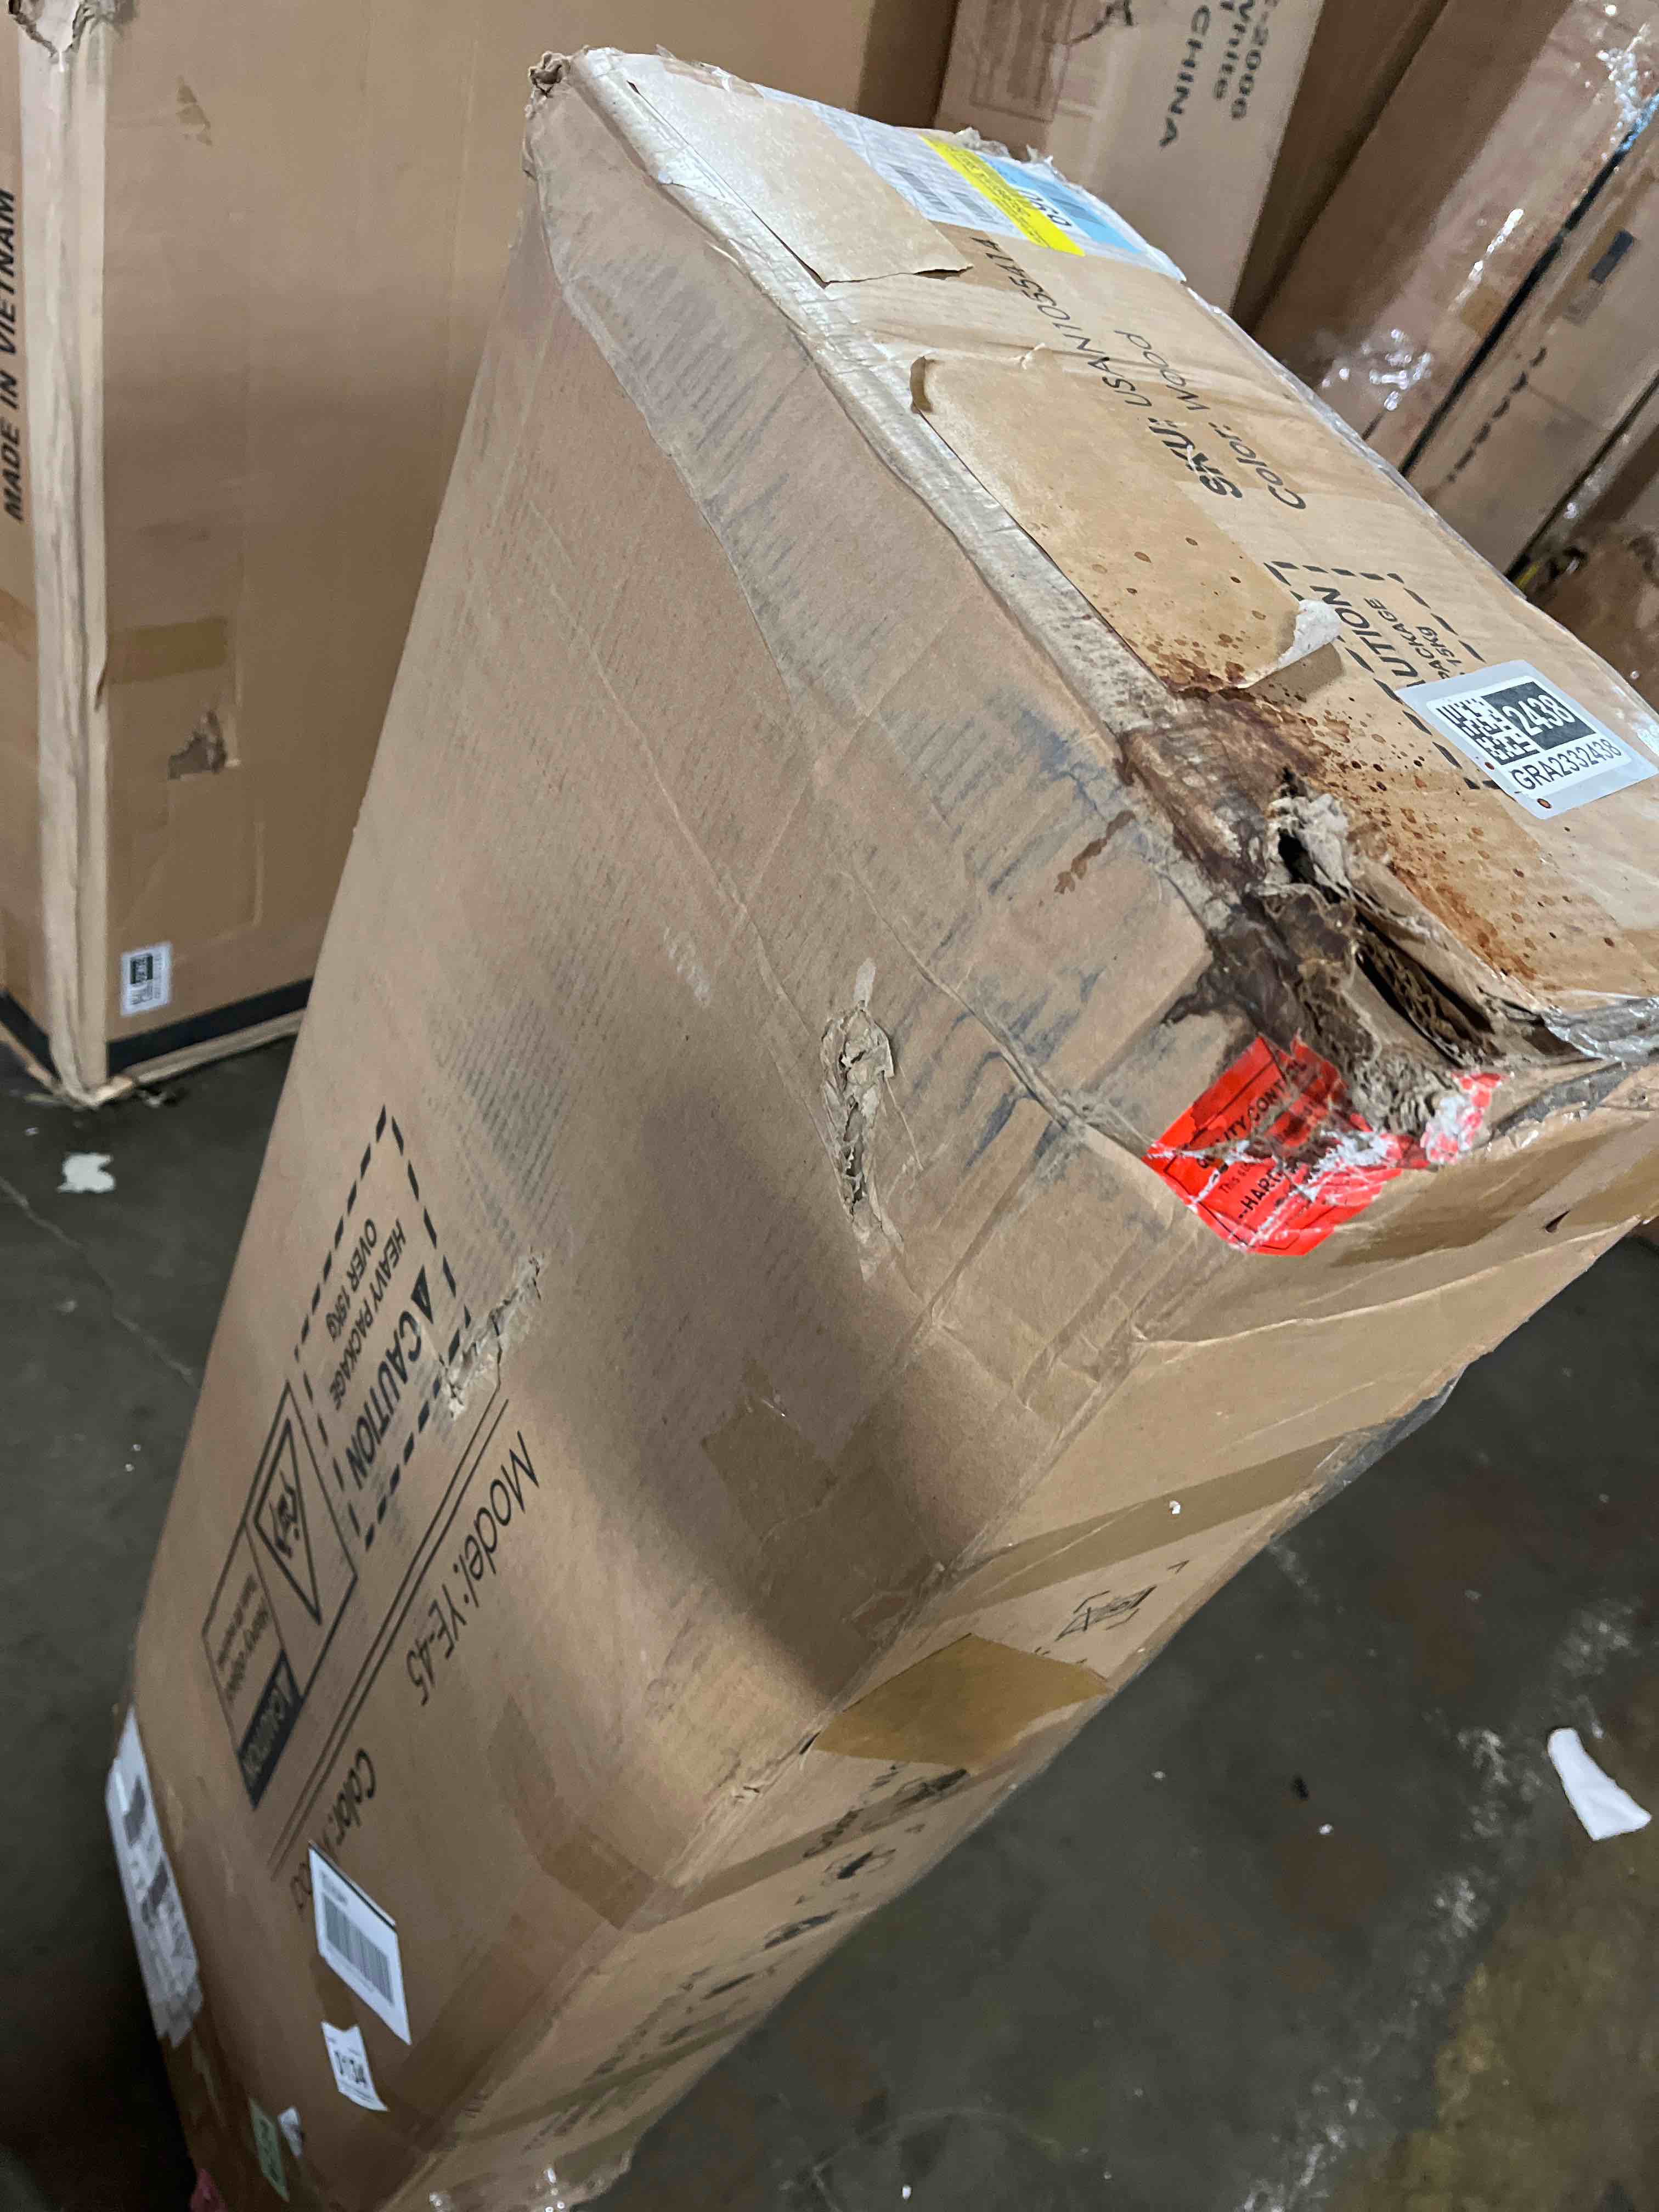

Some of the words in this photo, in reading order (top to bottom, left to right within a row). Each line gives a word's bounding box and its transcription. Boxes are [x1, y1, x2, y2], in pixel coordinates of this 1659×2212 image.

[1159, 4, 1210, 147] CHINA
[969, 236, 1153, 407] USAN1055414
[0, 369, 19, 410] IN
[1113, 330, 1210, 410] Wood
[2, 419, 24, 522] MADE
[1148, 417, 1243, 498] SKU:
[1208, 422, 1306, 510] Color:
[1502, 694, 1576, 736] 2438
[1509, 738, 1622, 790] GRA2332438
[346, 1218, 377, 1293] OVER
[370, 1218, 407, 1313] HEAVY
[329, 1297, 374, 1410] PACKAGE
[346, 1311, 422, 1491] CAUTION
[453, 1430, 539, 1608] Model:
